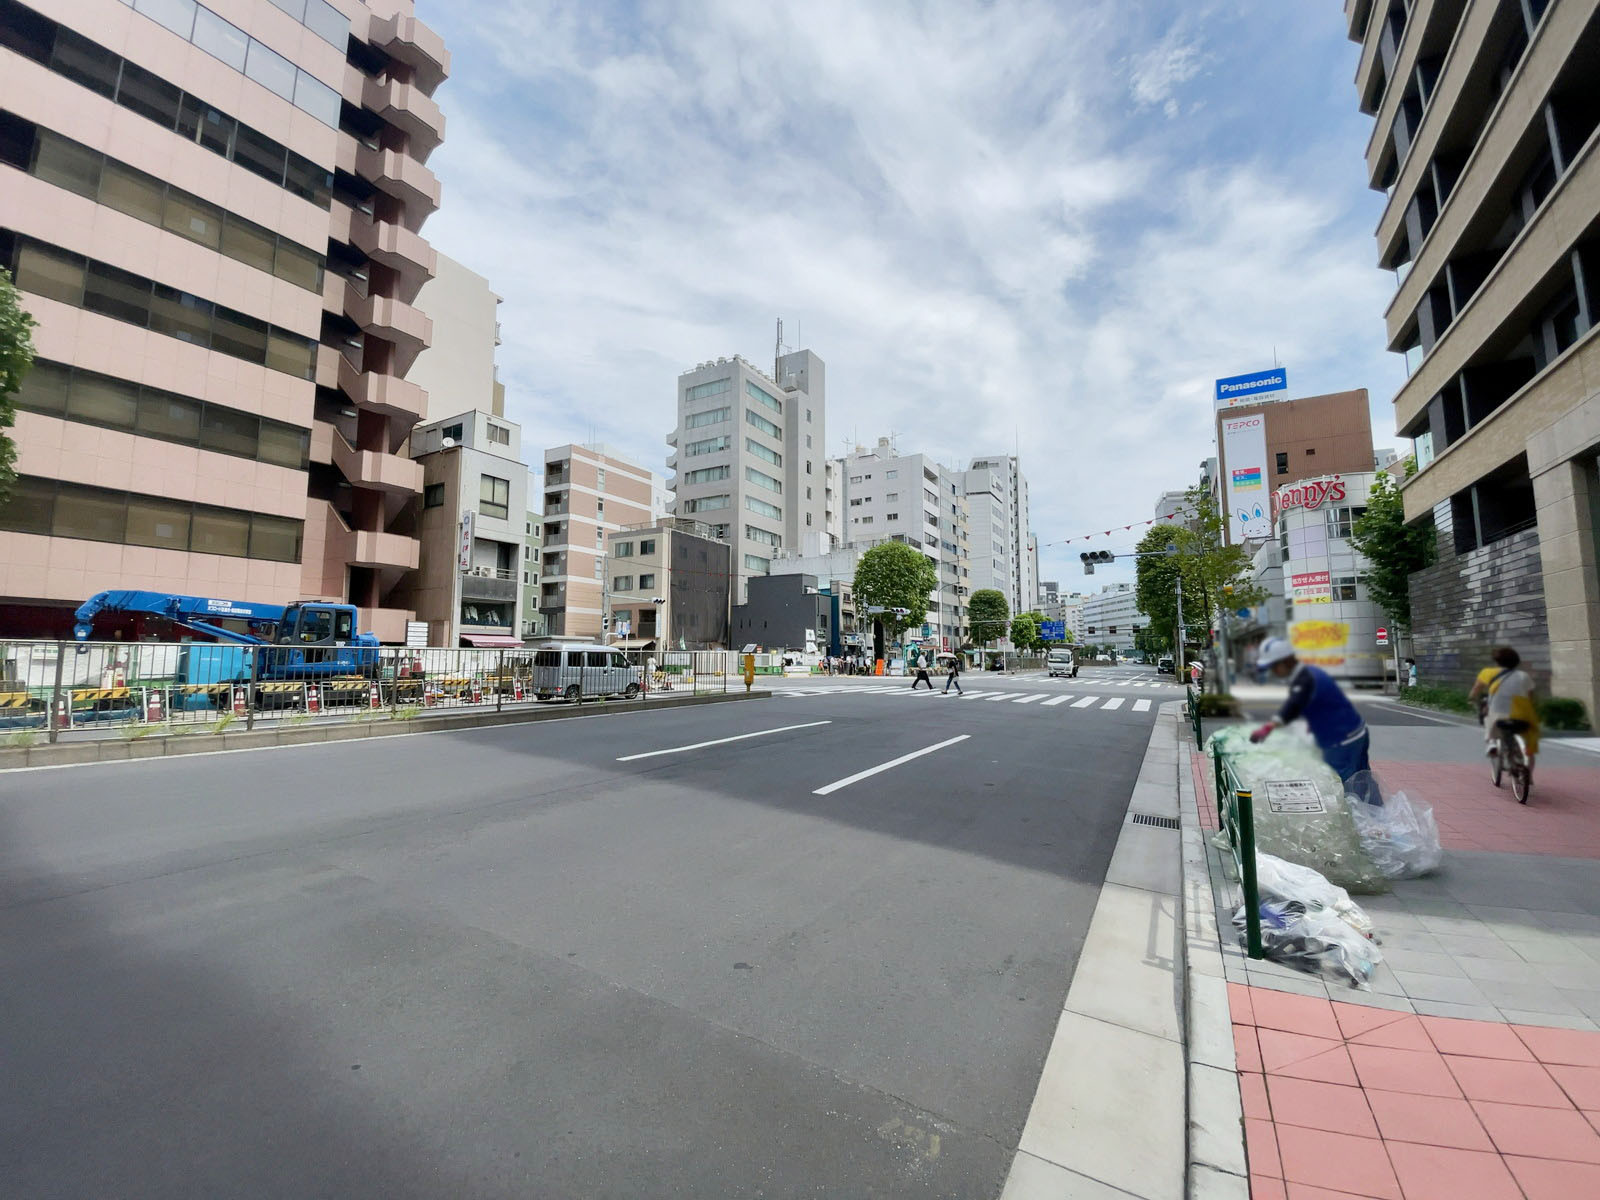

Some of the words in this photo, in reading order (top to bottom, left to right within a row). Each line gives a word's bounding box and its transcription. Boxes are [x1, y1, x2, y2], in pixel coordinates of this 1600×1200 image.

[1220, 376, 1282, 393] Panasonic
[1226, 419, 1260, 430] TEPCO
[1271, 475, 1346, 516] Denny's
